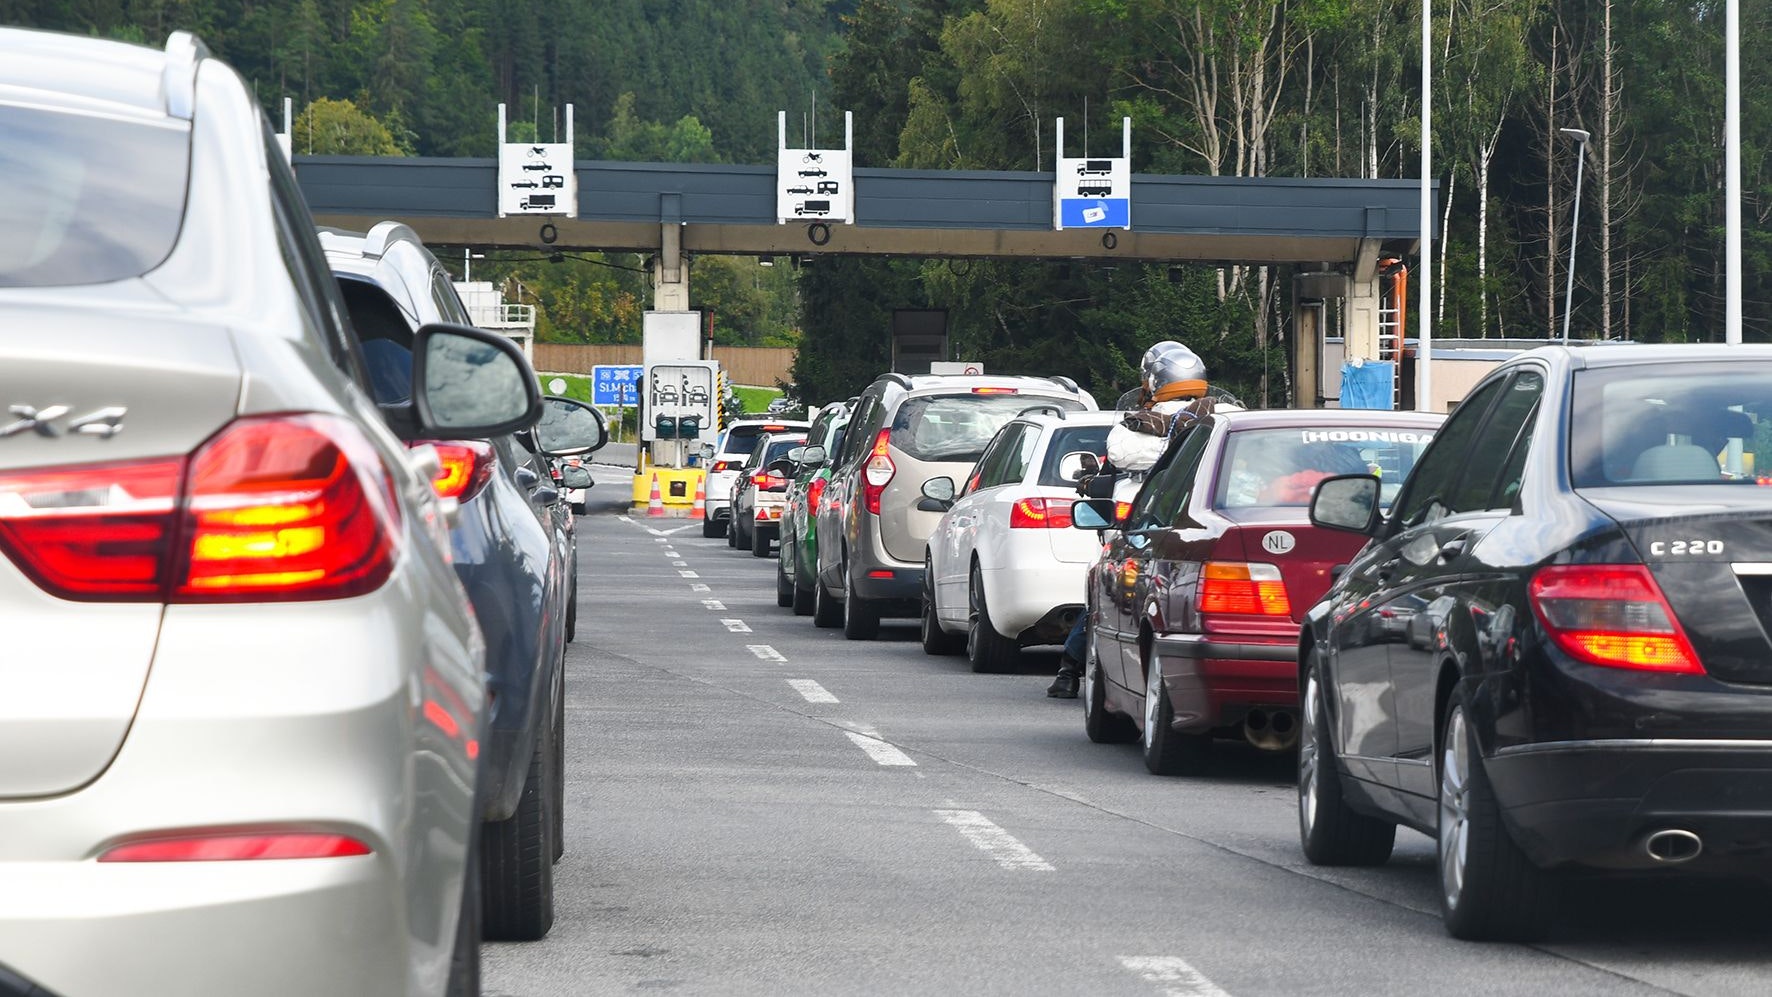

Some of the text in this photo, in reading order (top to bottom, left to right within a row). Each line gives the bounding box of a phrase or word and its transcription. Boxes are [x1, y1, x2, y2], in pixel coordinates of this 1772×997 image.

[0, 404, 129, 439] X4
[1267, 535, 1289, 550] NL
[1650, 540, 1725, 556] C 220
